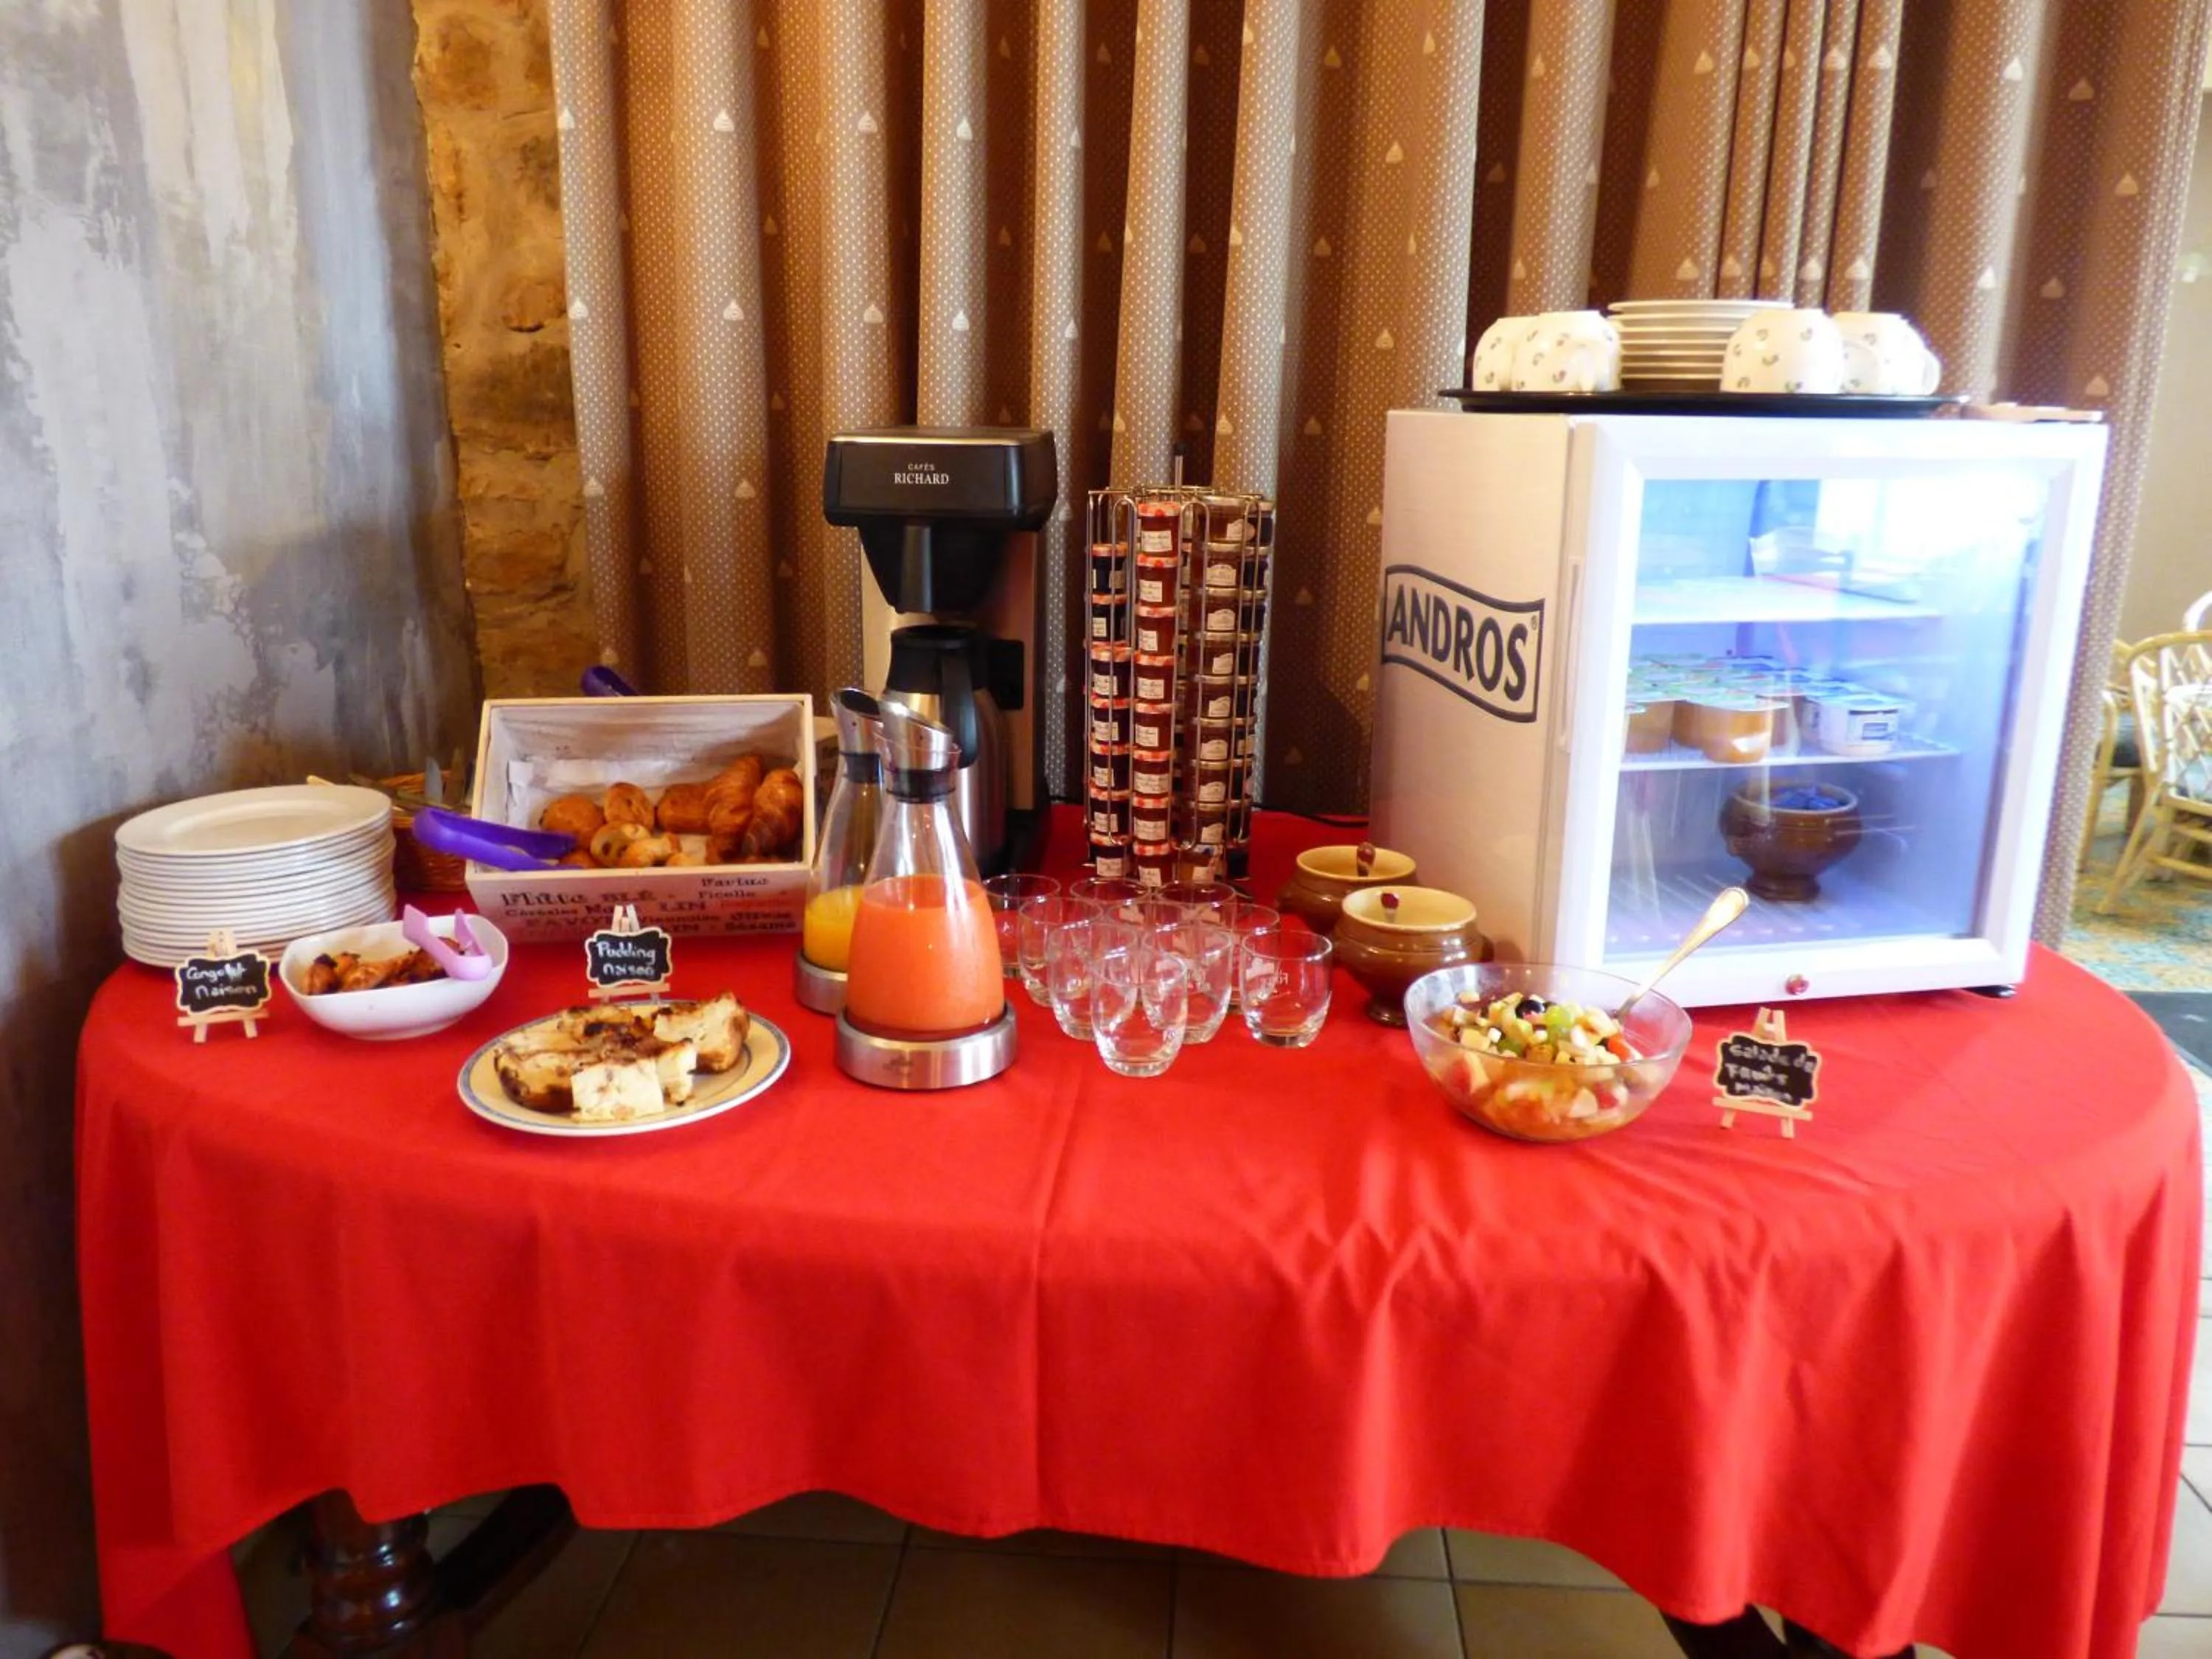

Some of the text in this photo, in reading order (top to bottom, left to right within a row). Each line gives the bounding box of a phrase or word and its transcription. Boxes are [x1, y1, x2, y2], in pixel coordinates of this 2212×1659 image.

[894, 473, 949, 484] RICHARD
[1387, 583, 1528, 702] ANDROS
[597, 941, 656, 965] Pudding
